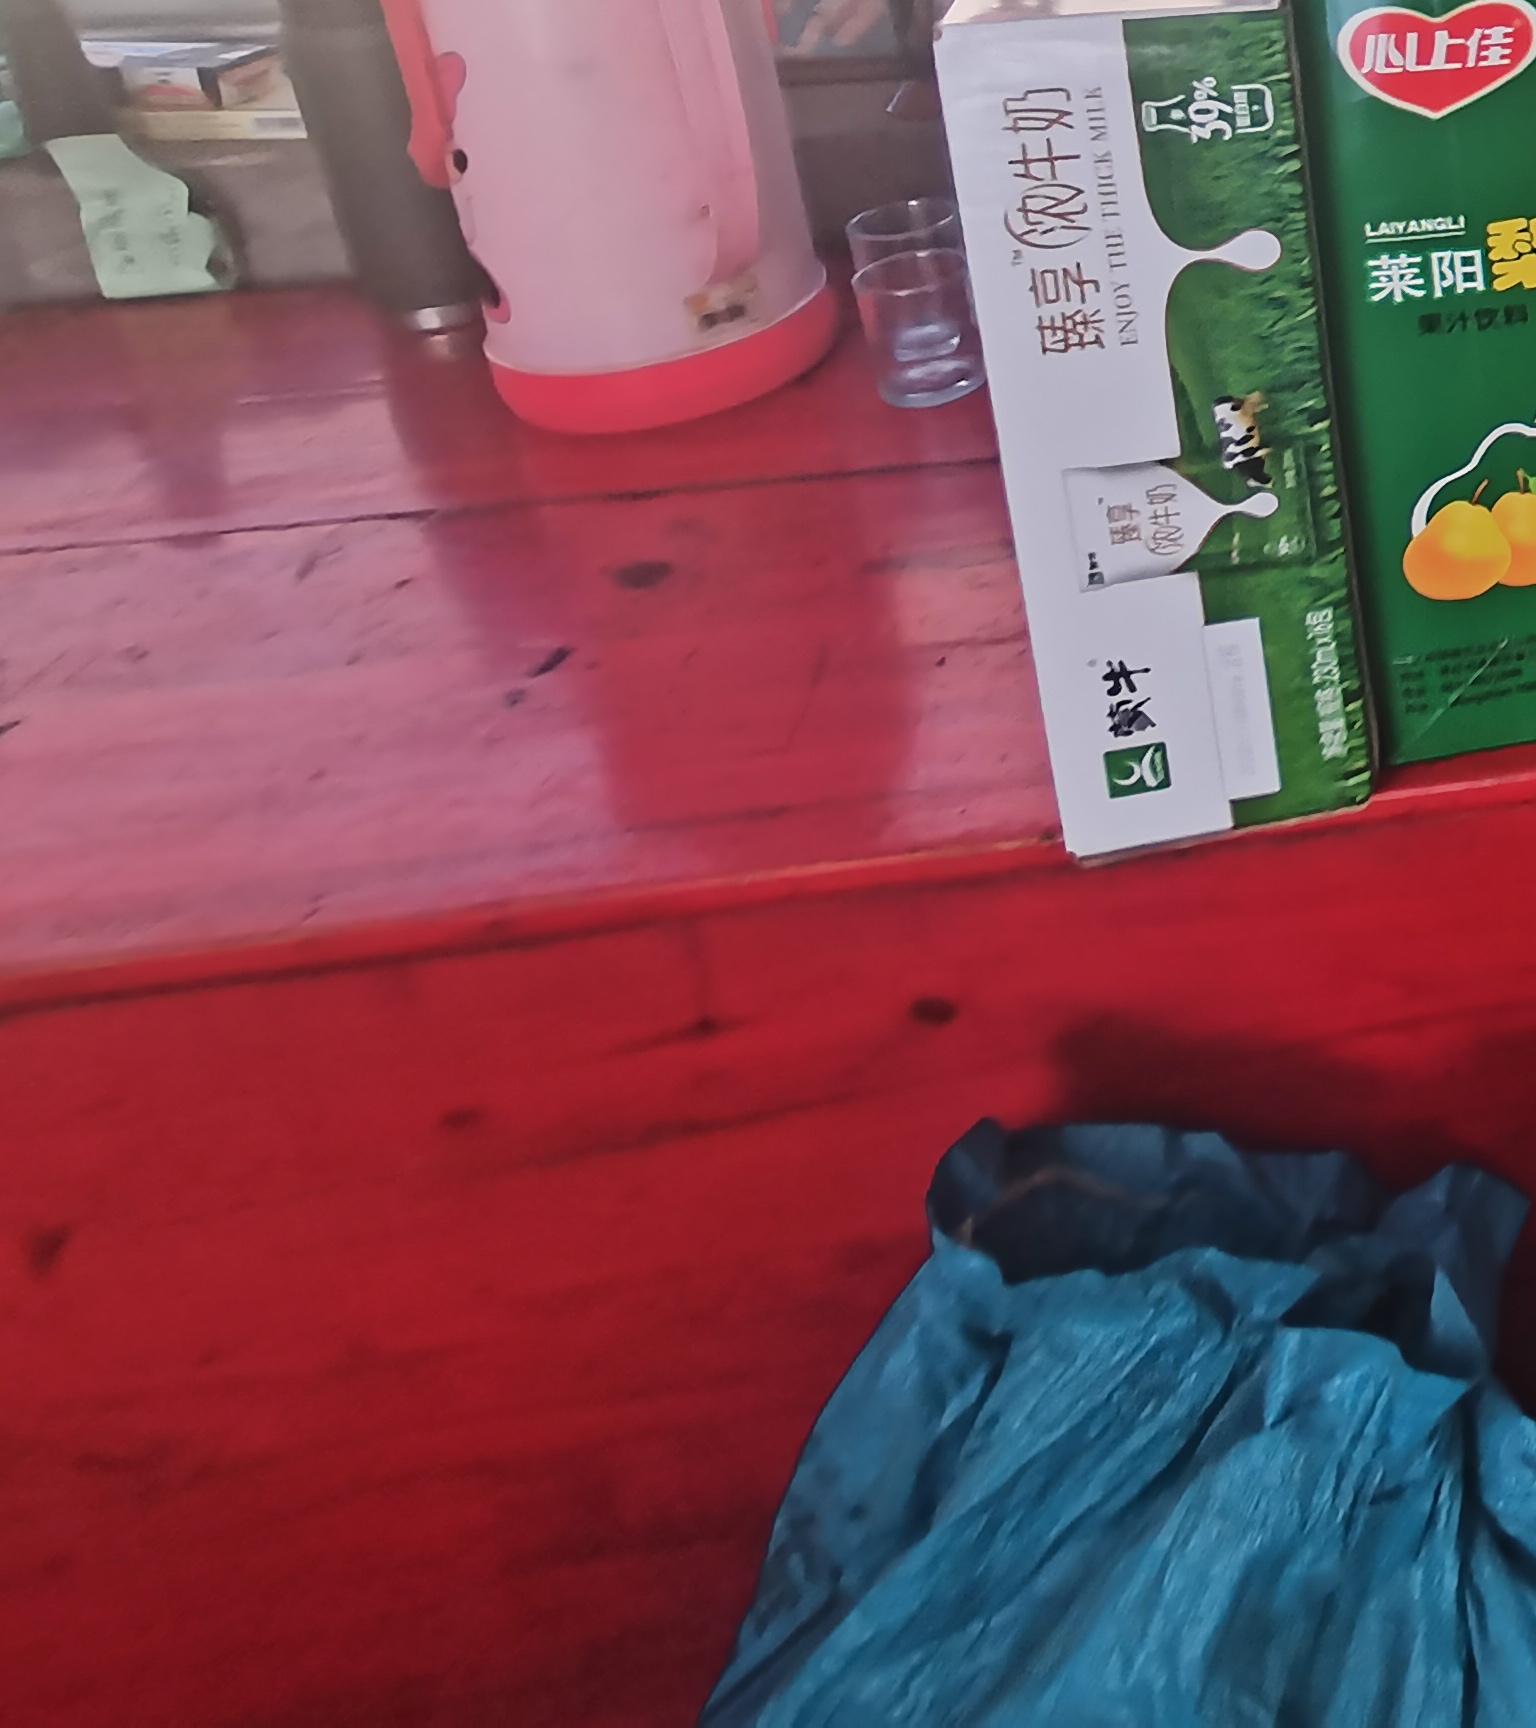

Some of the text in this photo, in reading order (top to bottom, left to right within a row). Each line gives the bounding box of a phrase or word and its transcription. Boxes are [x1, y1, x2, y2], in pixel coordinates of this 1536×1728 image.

[1361, 24, 1516, 75] 心上佳
[1187, 76, 1233, 143] 39%
[1092, 151, 1121, 218] THICK
[1105, 228, 1127, 272] THE
[1364, 214, 1465, 238] LAIYANGLI
[1113, 280, 1138, 347] ENJOY
[1101, 659, 1157, 738] 蒙牛
